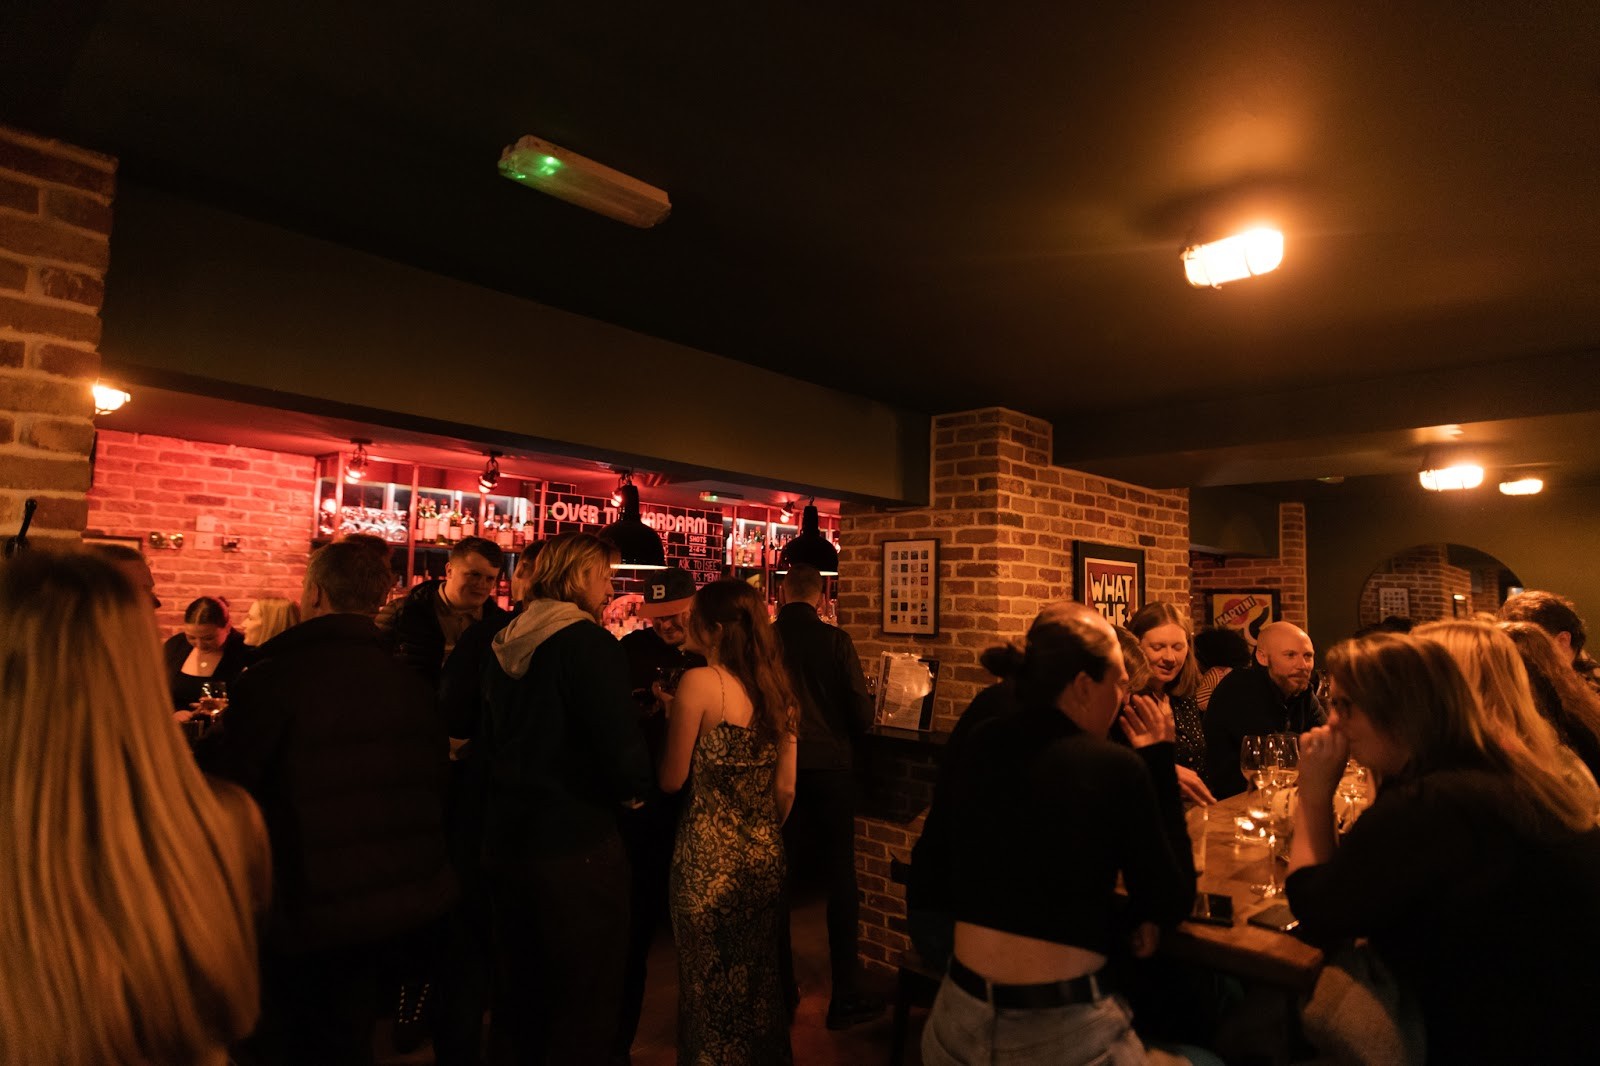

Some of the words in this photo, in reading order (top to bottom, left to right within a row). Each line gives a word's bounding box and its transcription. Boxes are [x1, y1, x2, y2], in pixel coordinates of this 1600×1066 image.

[551, 501, 599, 524] OVER
[641, 512, 707, 534] ARDARM
[689, 535, 707, 544] SHOTS
[693, 560, 702, 570] TO
[705, 561, 717, 571] SEE
[652, 584, 665, 599] B
[1090, 572, 1132, 602] WHAT
[1217, 596, 1256, 626] MARTINI
